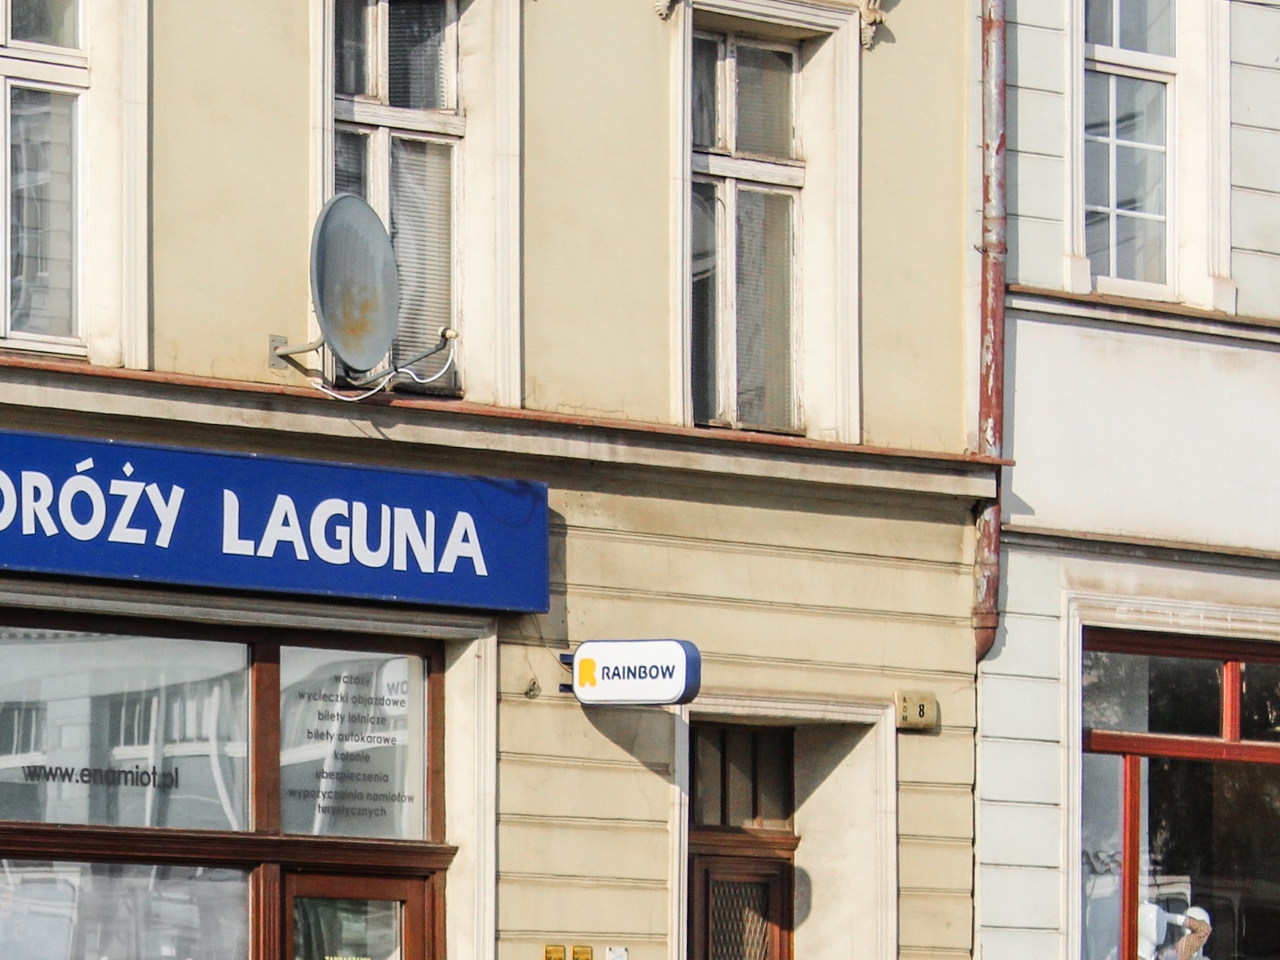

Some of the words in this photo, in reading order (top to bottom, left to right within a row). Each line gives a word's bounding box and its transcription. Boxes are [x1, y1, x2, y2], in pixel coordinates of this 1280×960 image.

[221, 488, 489, 577] LAGUNA
[602, 665, 676, 680] RAINBOW
[333, 674, 371, 687] wczasy
[298, 691, 348, 703] wycieczki
[351, 695, 406, 707] objazdowe
[317, 710, 345, 724] bilety
[348, 713, 387, 725] lotnicze
[918, 704, 925, 718] 8
[307, 729, 334, 742] bilety
[338, 731, 397, 745] autokarowe
[334, 750, 371, 762] kolonie
[23, 764, 179, 792] www.enamiot.pl
[315, 769, 389, 783] ubezpieczenia
